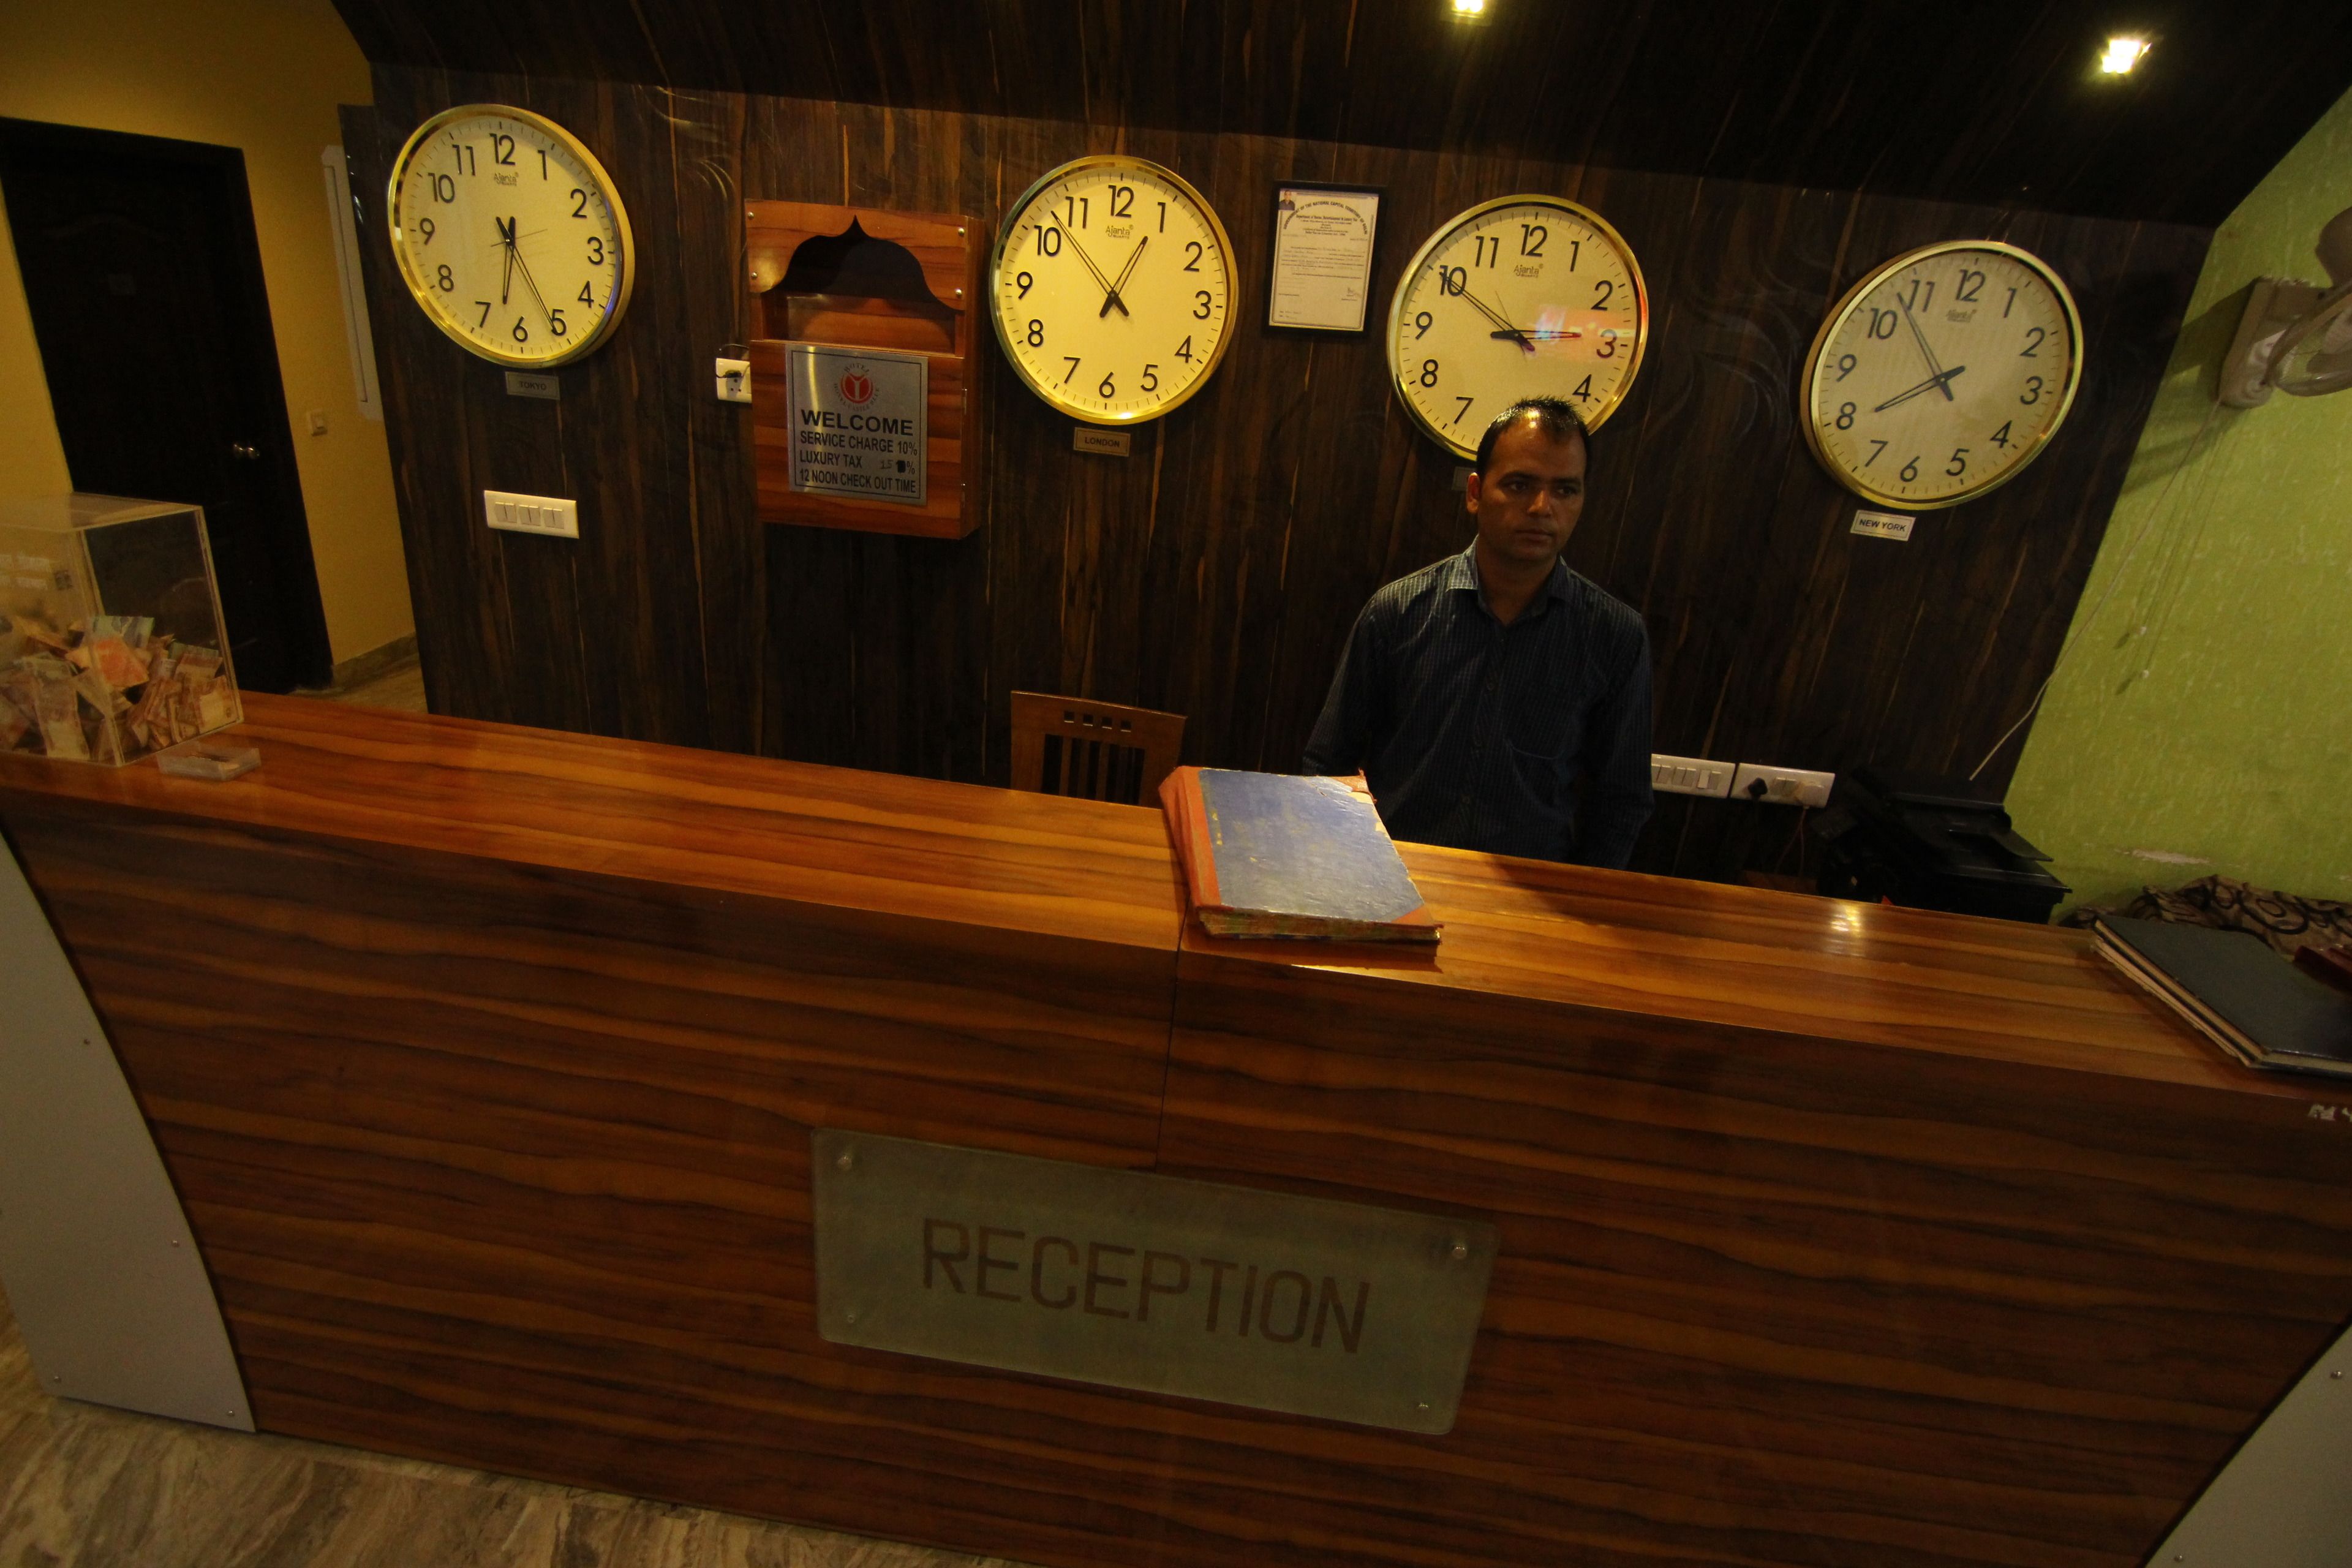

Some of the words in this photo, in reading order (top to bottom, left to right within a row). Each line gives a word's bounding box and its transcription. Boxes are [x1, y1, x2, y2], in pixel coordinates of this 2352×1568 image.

[452, 145, 475, 176] 11
[489, 133, 516, 165] 12
[538, 149, 548, 180] 1
[428, 173, 455, 203] 10
[1108, 184, 1134, 218] 12
[570, 188, 587, 218] 2
[1065, 196, 1088, 229] 11
[1157, 202, 1166, 233] 1
[420, 217, 435, 245] 9
[1034, 225, 1061, 257] 10
[1106, 225, 1130, 237] Ajanta
[1521, 224, 1548, 257] 12
[587, 236, 605, 265] 3
[1183, 241, 1203, 272] 2
[1475, 236, 1500, 268] 11
[1570, 241, 1580, 272] 1
[438, 265, 454, 292] 8
[1017, 271, 1033, 300] 9
[1439, 265, 1467, 297] 10
[1955, 270, 1986, 303] 12
[578, 281, 594, 308] 4
[1193, 290, 1212, 320] 3
[1591, 280, 1614, 311] 2
[1907, 279, 1936, 313] 11
[2003, 287, 2018, 318] 1
[475, 301, 491, 328] 7
[512, 316, 528, 342] 6
[551, 309, 567, 336] 5
[1415, 311, 1433, 341] 9
[1868, 307, 1898, 340] 10
[1028, 319, 1044, 347] 8
[1596, 329, 1618, 358] 3
[2020, 327, 2045, 358] 2
[1175, 335, 1193, 363] 4
[1064, 356, 1081, 384] 7
[1140, 364, 1158, 392] 5
[1420, 359, 1439, 388] 8
[1836, 354, 1858, 382] 9
[519, 380, 547, 391] TOKYO
[1099, 371, 1115, 398] 6
[1572, 374, 1592, 402] 4
[2021, 375, 2043, 405] 3
[801, 409, 913, 436] WELCOME
[1454, 397, 1474, 424] 7
[1836, 402, 1856, 431] 8
[801, 431, 845, 447] SERVICE
[849, 436, 894, 453] CHARGE
[897, 440, 918, 456] 10%
[1084, 437, 1120, 448] LONDON
[1989, 420, 2013, 449] 4
[800, 450, 840, 466] LUXURY
[843, 454, 862, 469] TAX
[1865, 440, 1888, 467] 7
[1945, 448, 1970, 477] 5
[800, 469, 810, 481] 12
[812, 470, 838, 484] NOON
[840, 473, 872, 488] CHECK
[874, 477, 892, 490] OUT
[895, 478, 916, 493] TIME
[1900, 456, 1921, 483] 6
[1858, 518, 1880, 528] NEW
[1882, 520, 1906, 532] YORK
[922, 1218, 1371, 1354] RECEPTION
